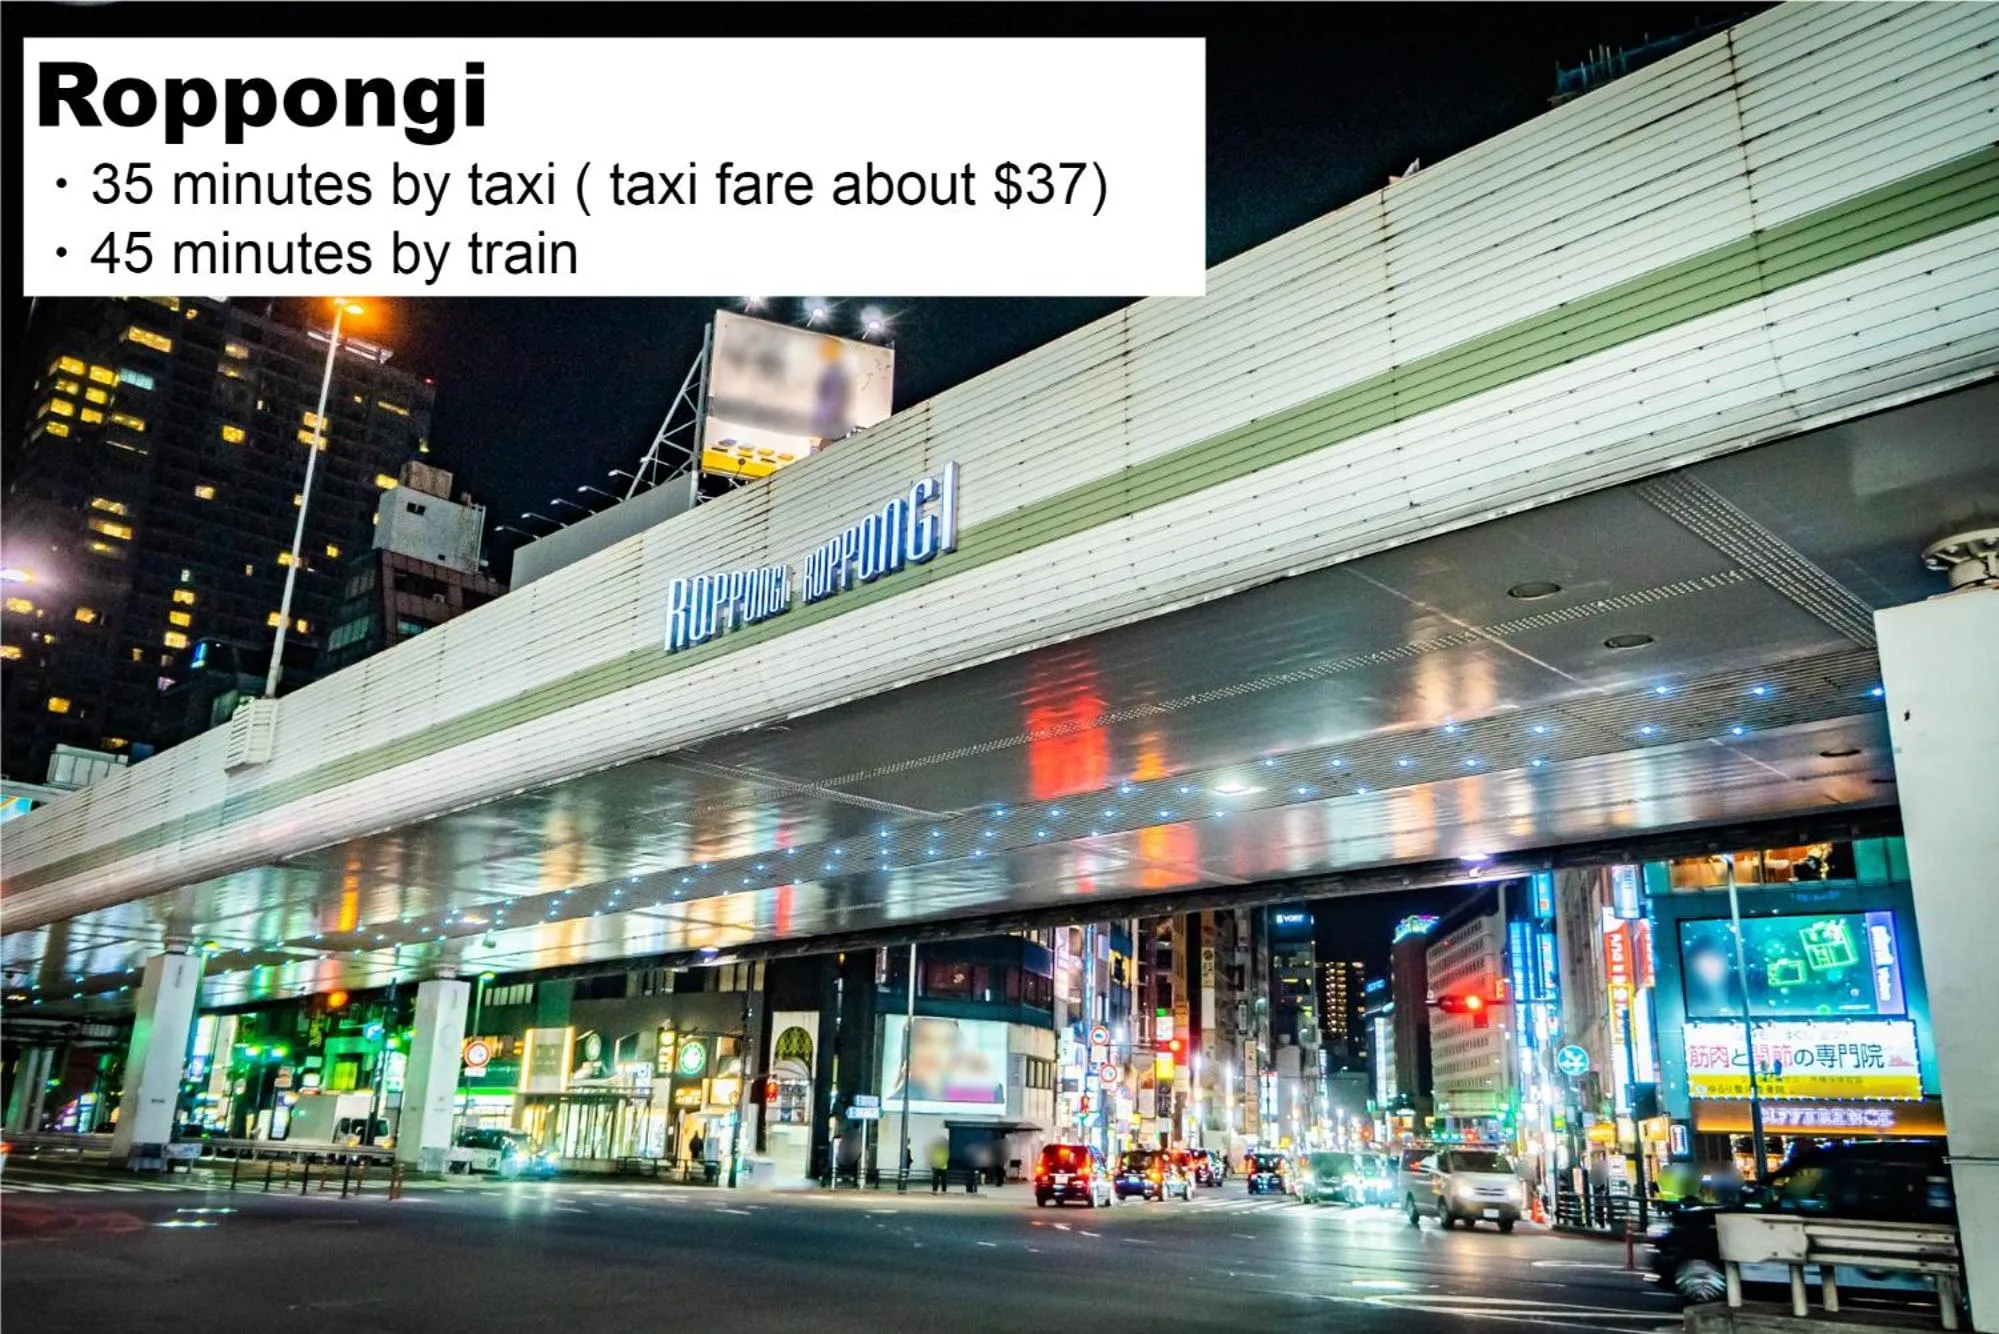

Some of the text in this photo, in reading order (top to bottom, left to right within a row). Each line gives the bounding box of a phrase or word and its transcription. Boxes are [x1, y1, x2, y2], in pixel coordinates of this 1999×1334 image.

[664, 460, 961, 654] ROPPONGI ROPPONGI
[1688, 1042, 1885, 1070] 筋肉と関節の専門院
